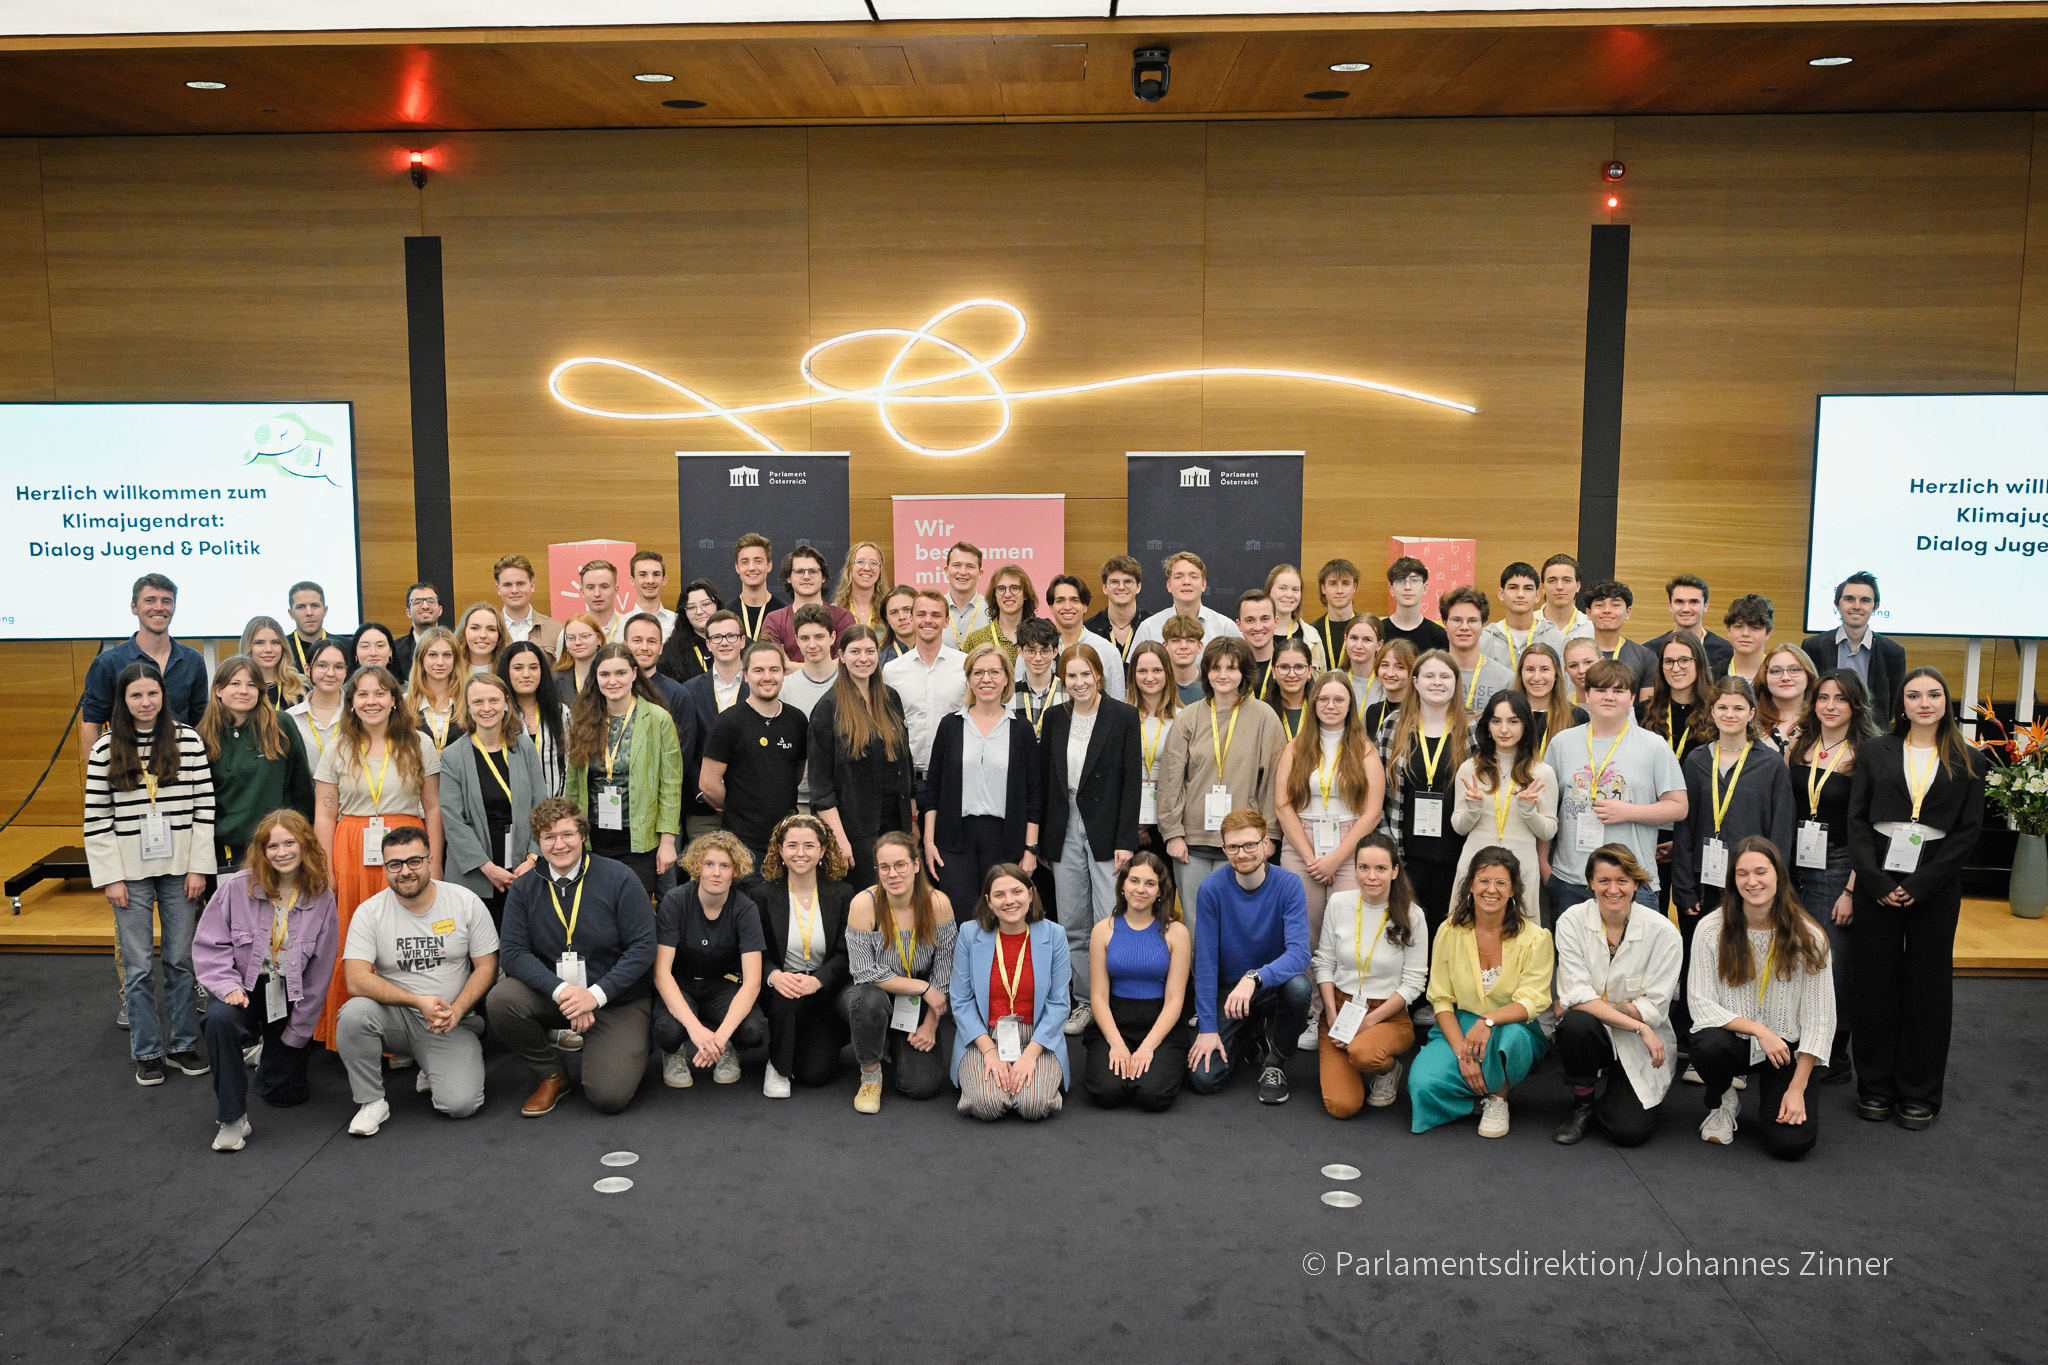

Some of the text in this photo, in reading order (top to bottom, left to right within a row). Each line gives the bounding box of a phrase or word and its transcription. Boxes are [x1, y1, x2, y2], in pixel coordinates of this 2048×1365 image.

[769, 470, 807, 478] Parlament
[769, 477, 807, 485] Österreich
[1220, 477, 1259, 486] Österreich
[16, 484, 267, 500] Herzlich willkommen zum
[1910, 477, 2048, 494] Herzlich will
[62, 512, 225, 533] Klimajugendrat:
[914, 519, 955, 537] Wir
[29, 539, 261, 561] Dialog Jugend & Politik
[915, 543, 1034, 560] besmen
[1916, 535, 1988, 556] Dialog
[396, 936, 444, 951] RETTEN
[402, 948, 440, 959] WIR DIE
[396, 957, 446, 973] WELT
